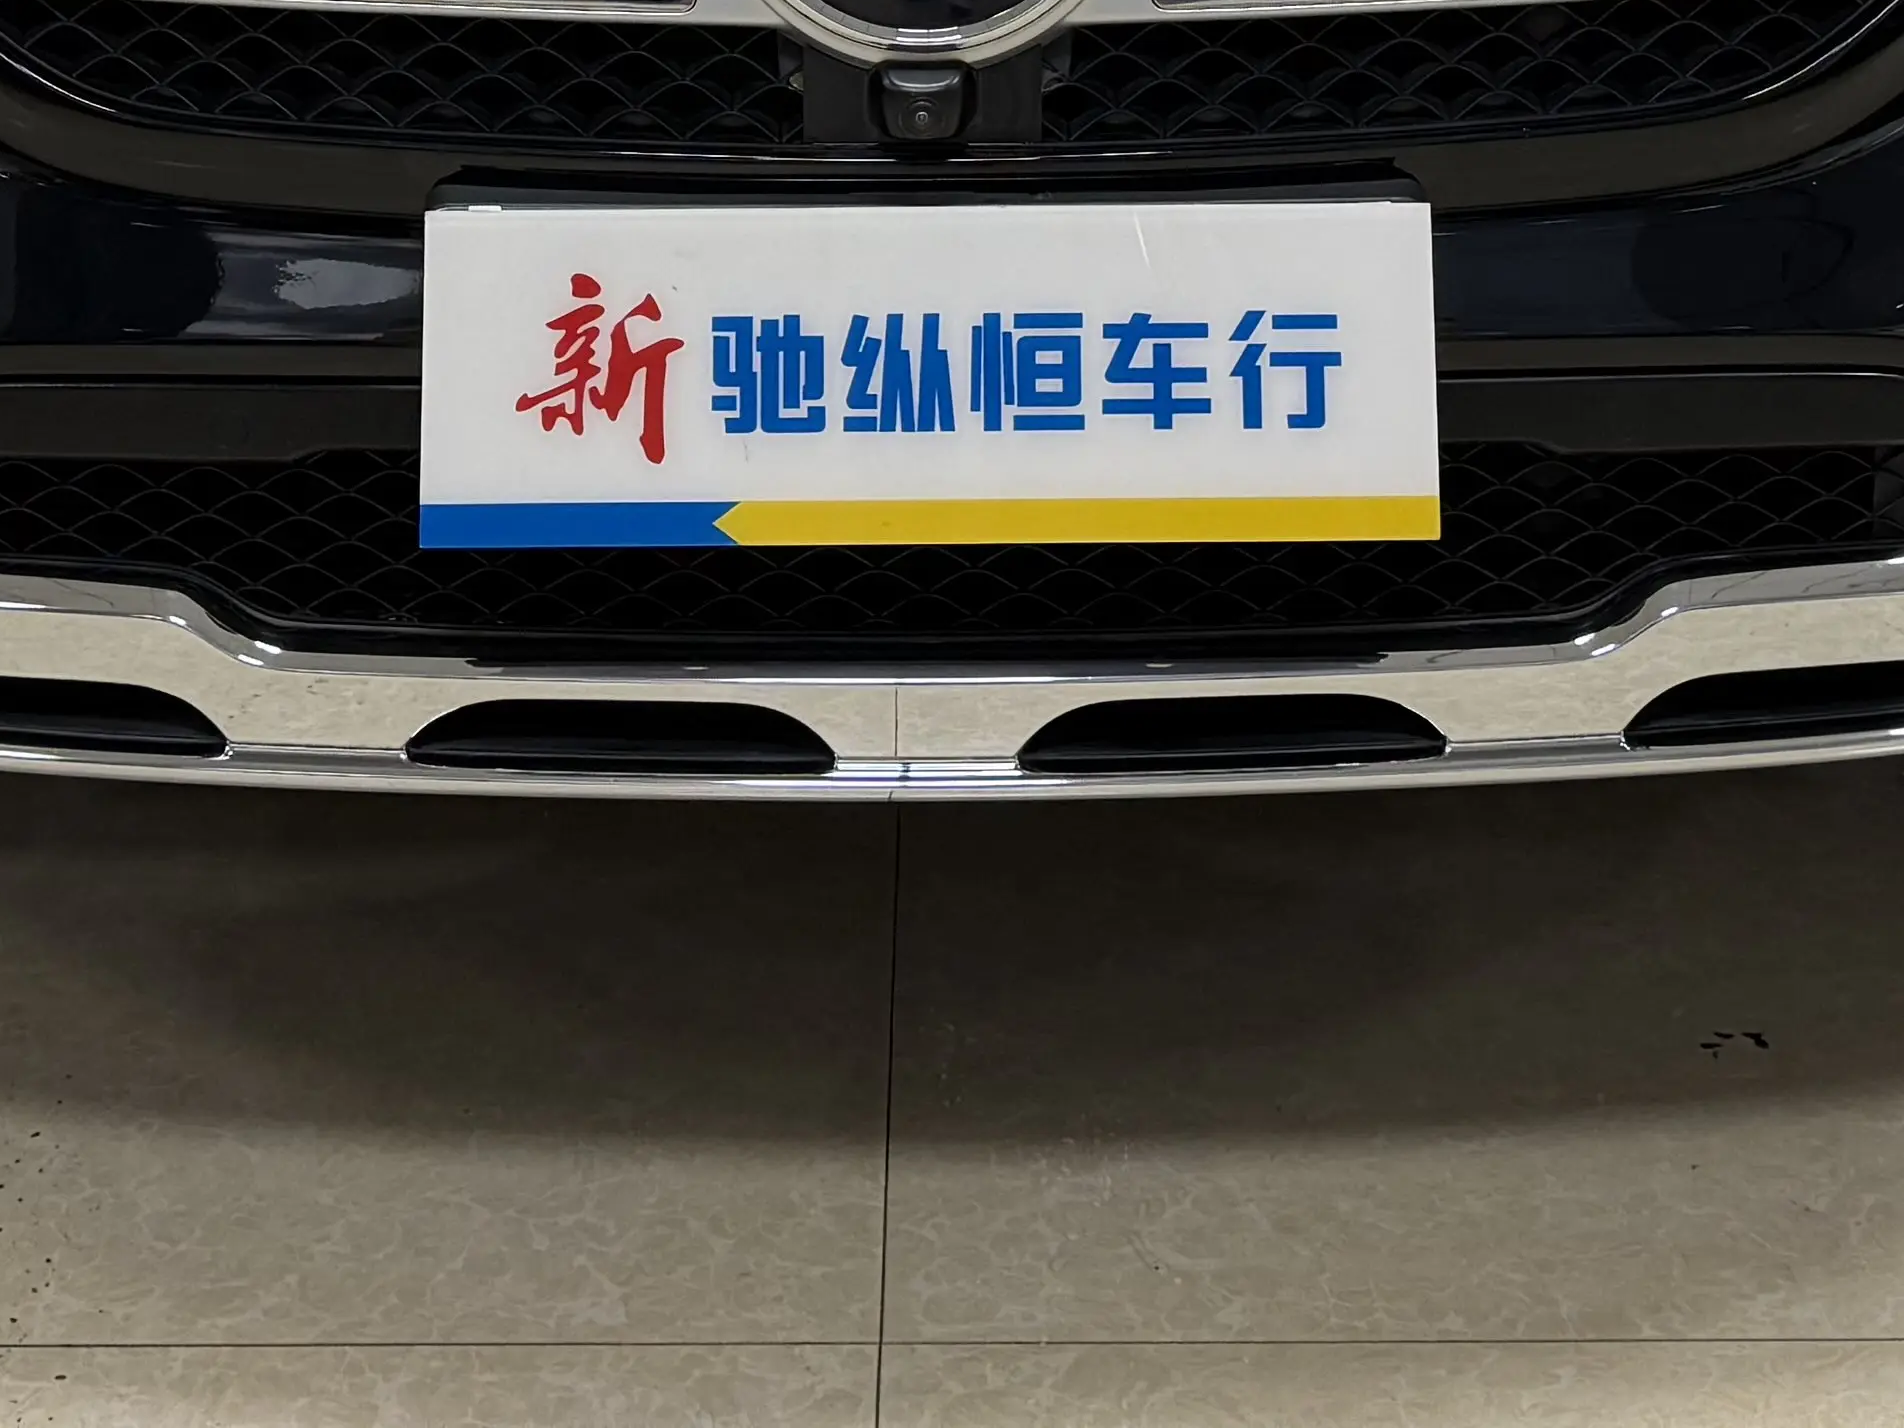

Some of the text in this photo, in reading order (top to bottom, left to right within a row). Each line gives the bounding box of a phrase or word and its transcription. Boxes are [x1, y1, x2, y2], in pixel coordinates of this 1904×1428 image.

[515, 273, 1344, 465] 新驰纵恒车行
